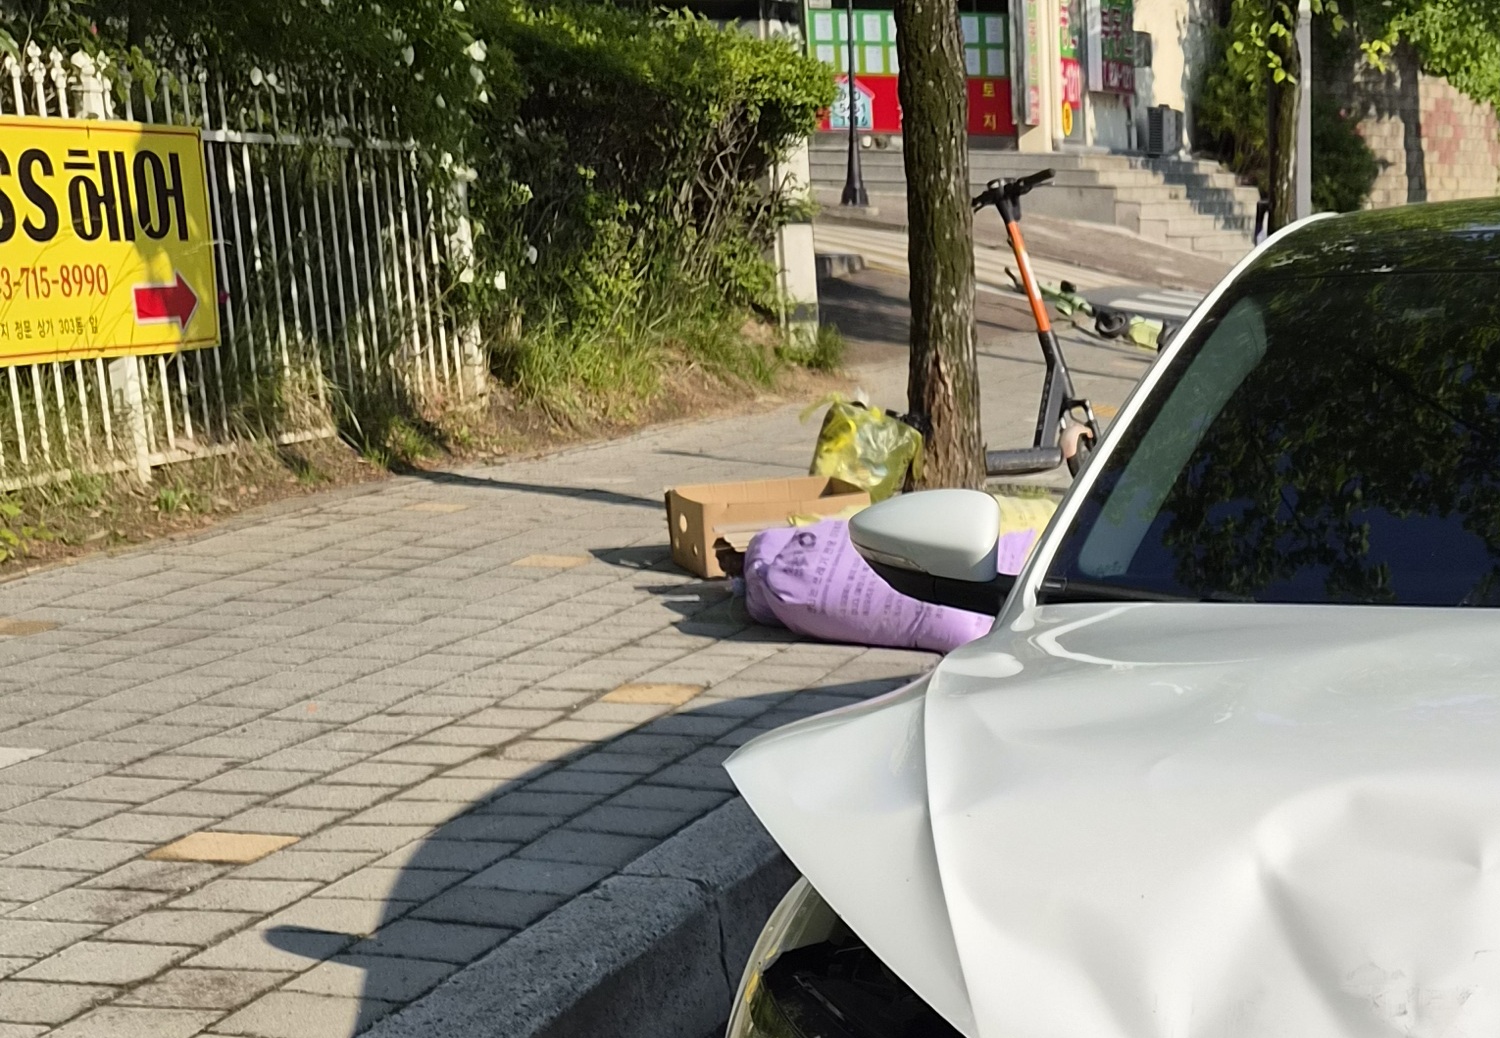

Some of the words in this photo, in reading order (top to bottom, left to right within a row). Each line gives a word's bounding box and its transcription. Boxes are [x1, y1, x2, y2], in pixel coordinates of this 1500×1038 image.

[0, 264, 109, 300] 3-715-8990
[15, 320, 32, 340] 정문
[37, 318, 54, 338] 상가
[59, 316, 84, 335] 303동
